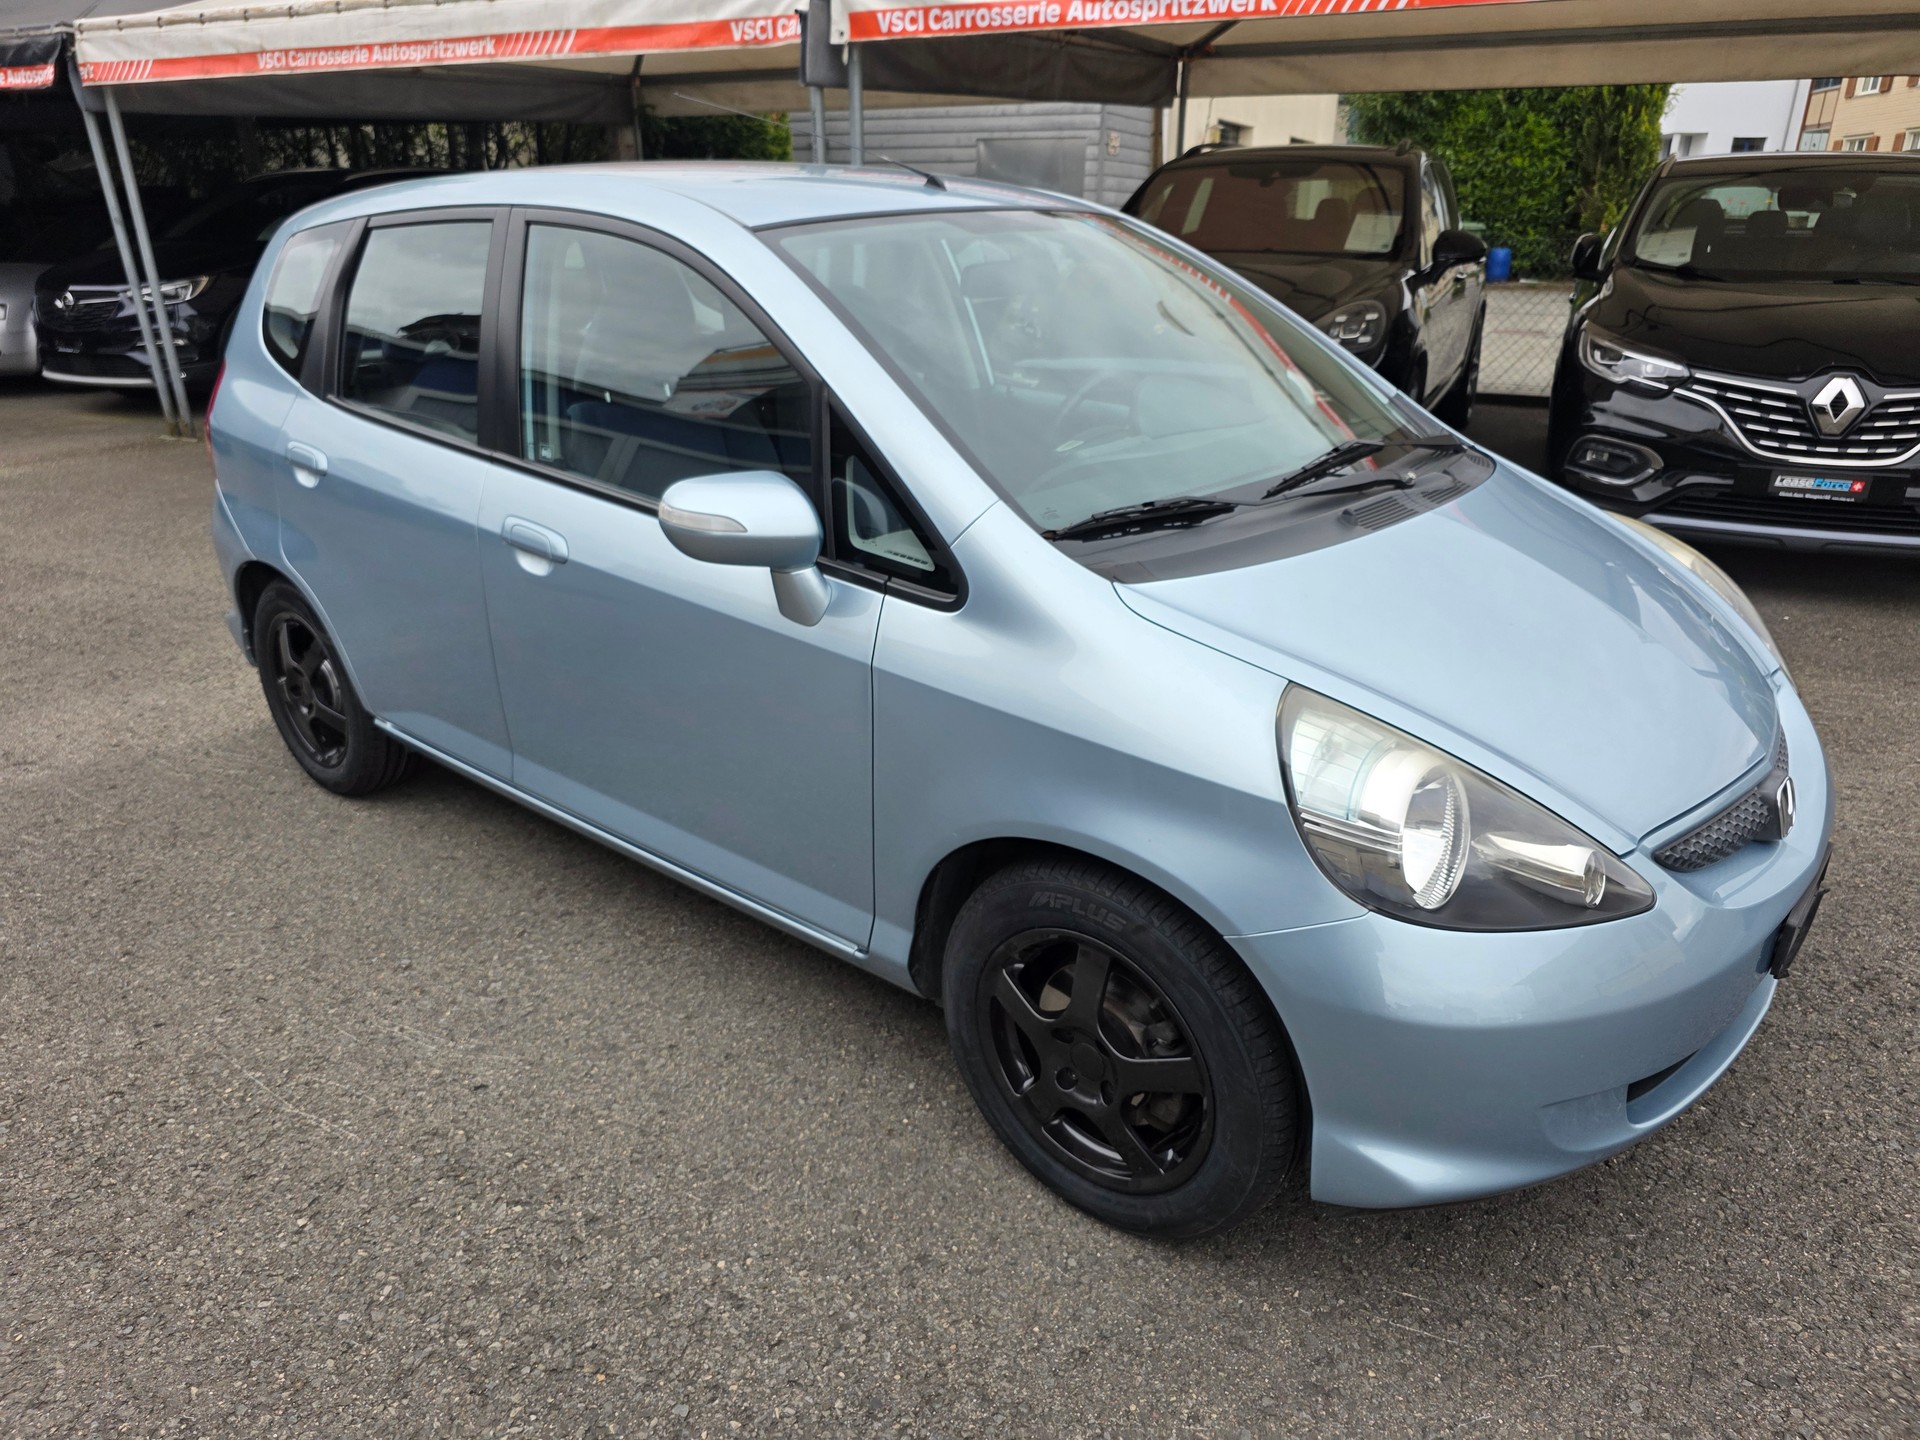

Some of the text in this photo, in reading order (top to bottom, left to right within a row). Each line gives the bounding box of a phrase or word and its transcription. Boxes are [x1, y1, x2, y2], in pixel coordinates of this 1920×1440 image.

[730, 19, 773, 42] VSCI
[876, 10, 924, 34] VSCI
[928, 1, 1061, 31] Carrosserie
[257, 36, 497, 70] VSCI Carrosserie Autospritzwerk
[1774, 475, 1851, 490] LeaseForce
